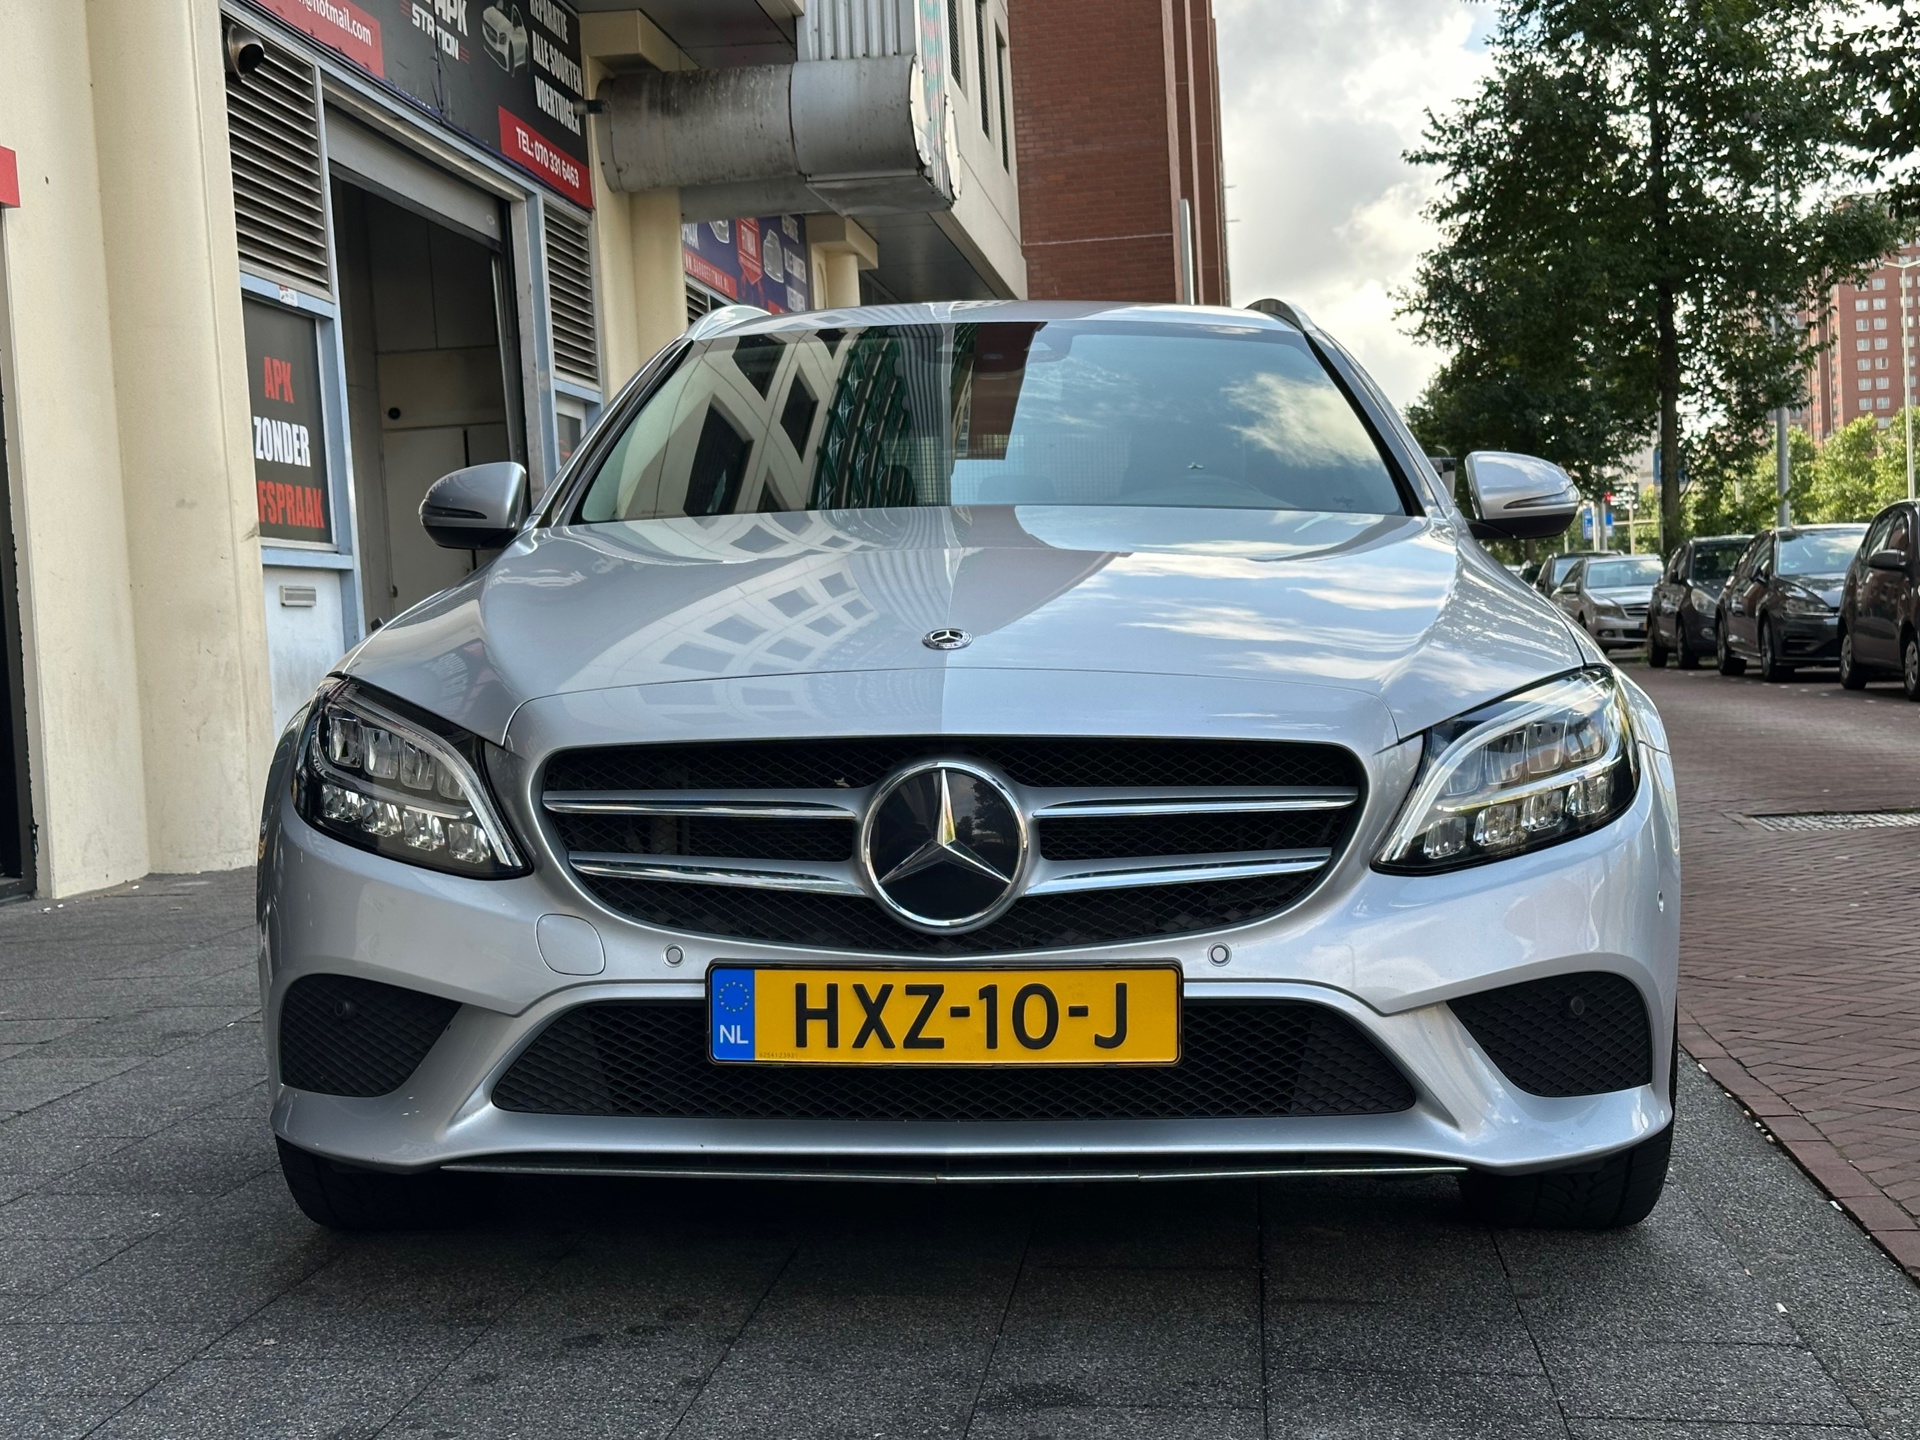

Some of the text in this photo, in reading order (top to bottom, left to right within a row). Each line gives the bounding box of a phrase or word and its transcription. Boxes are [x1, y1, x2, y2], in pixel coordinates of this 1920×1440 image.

[298, 0, 372, 47] @hotmail.com
[412, 3, 459, 60] STATION
[532, 30, 583, 97] ALLE SOORTEN
[516, 126, 579, 189] TEL: 070 331 6463
[263, 356, 295, 404] APK
[253, 416, 311, 467] ZONDER
[257, 480, 325, 529] FSPRAAK
[719, 1024, 749, 1045] NL
[795, 981, 1129, 1049] HXZ-10-J
